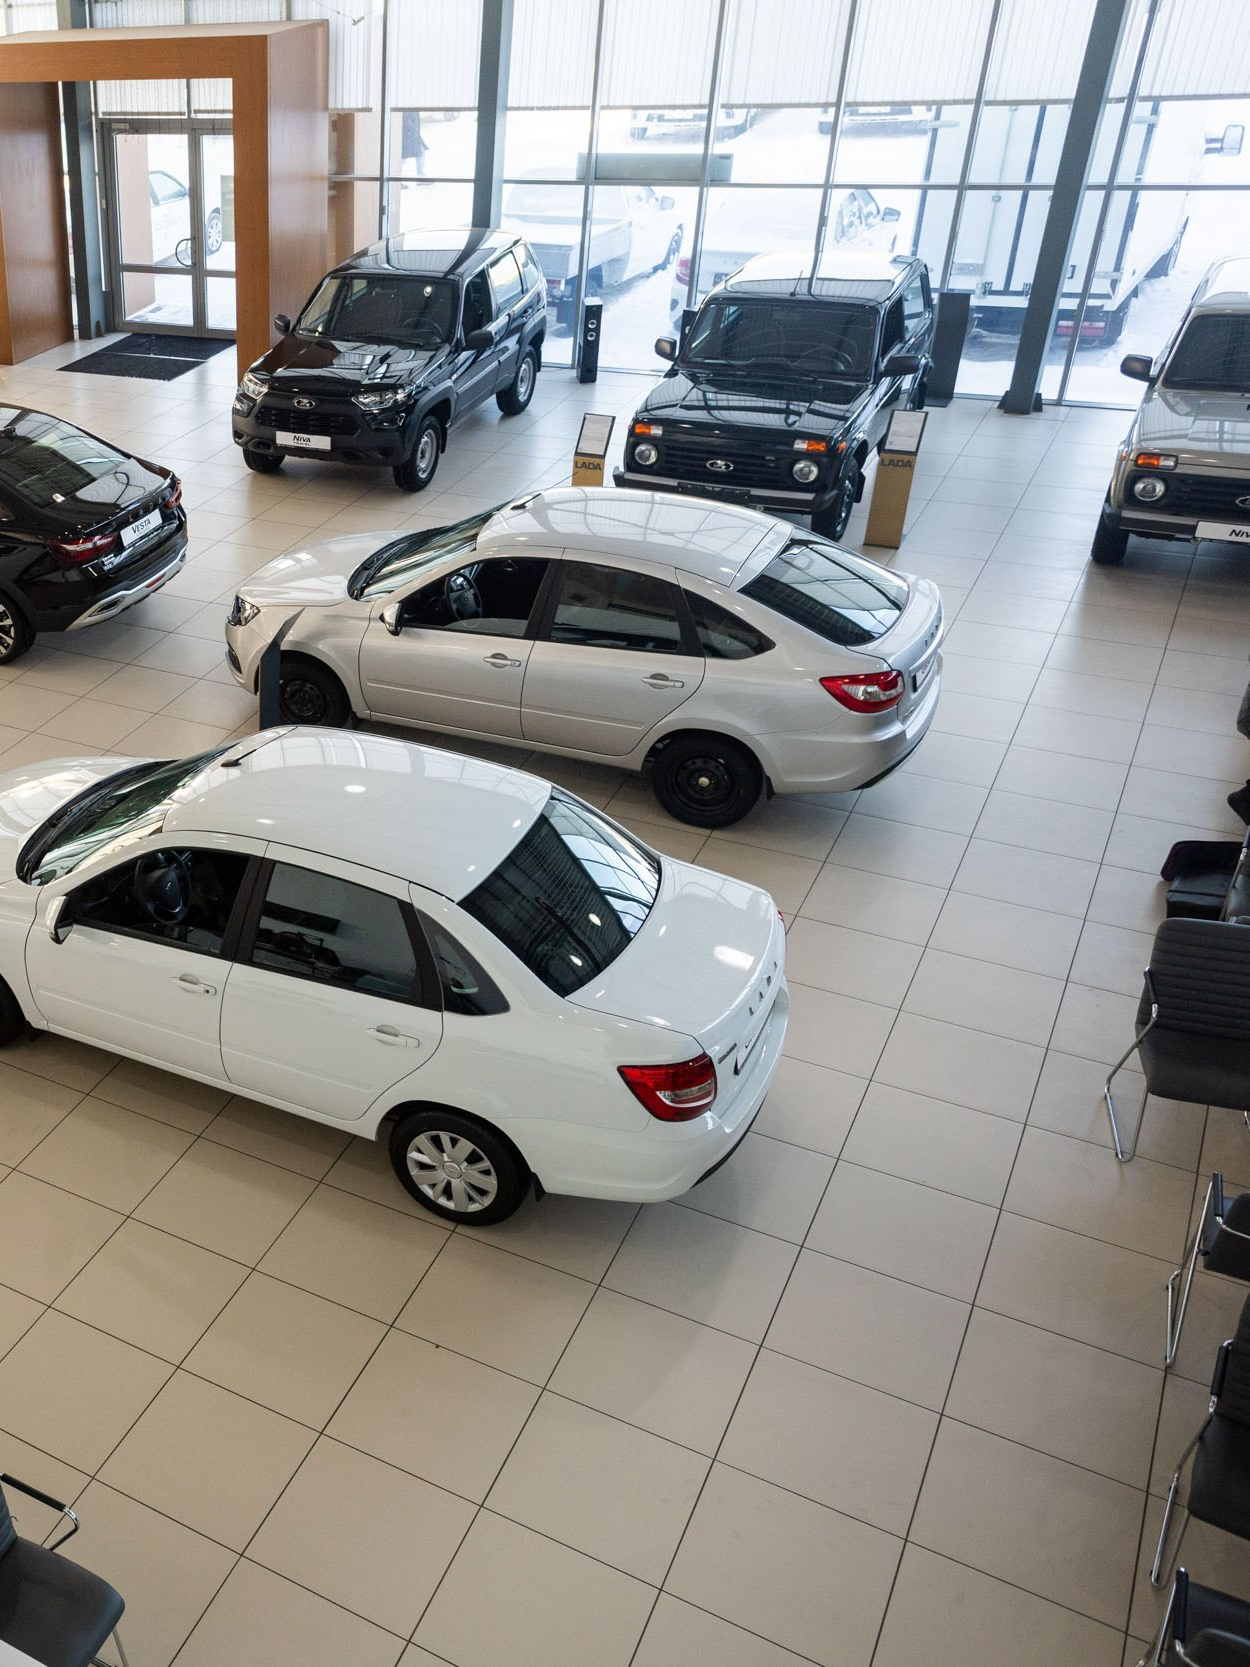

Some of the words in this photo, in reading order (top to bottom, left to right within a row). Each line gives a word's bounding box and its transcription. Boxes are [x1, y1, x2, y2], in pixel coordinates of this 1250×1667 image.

[575, 461, 601, 471] LADA
[881, 458, 912, 468] LADA
[132, 518, 151, 534] VESTA
